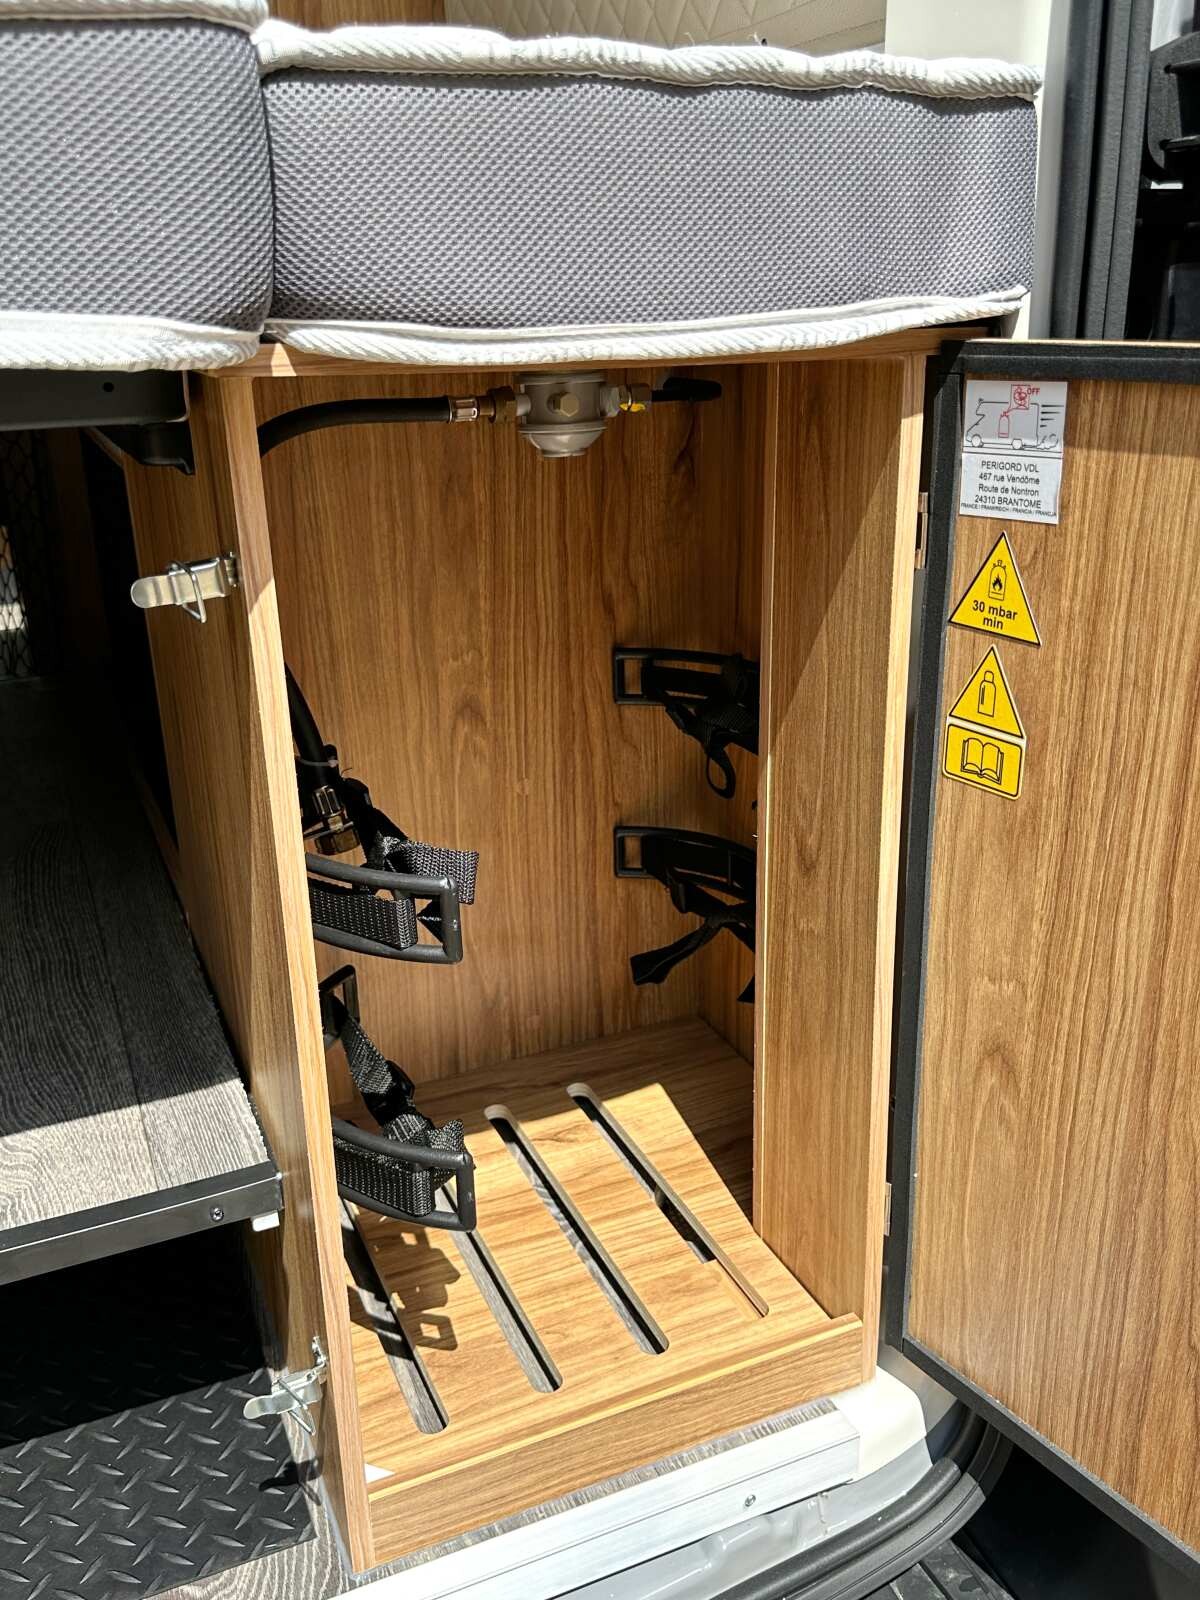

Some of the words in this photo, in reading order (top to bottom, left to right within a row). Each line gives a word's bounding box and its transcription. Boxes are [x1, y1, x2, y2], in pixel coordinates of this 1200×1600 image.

[981, 460, 1022, 472] PERIGORD
[1024, 464, 1039, 473] VDL
[1006, 474, 1040, 485] Vendôme
[978, 484, 998, 493] Route
[1000, 486, 1009, 494] de
[1011, 487, 1039, 496] Nontron
[975, 495, 996, 504] 24310
[997, 497, 1041, 508] BRANTOME
[972, 599, 985, 612] 30
[988, 606, 1018, 621] mbar
[983, 617, 1003, 630] min
